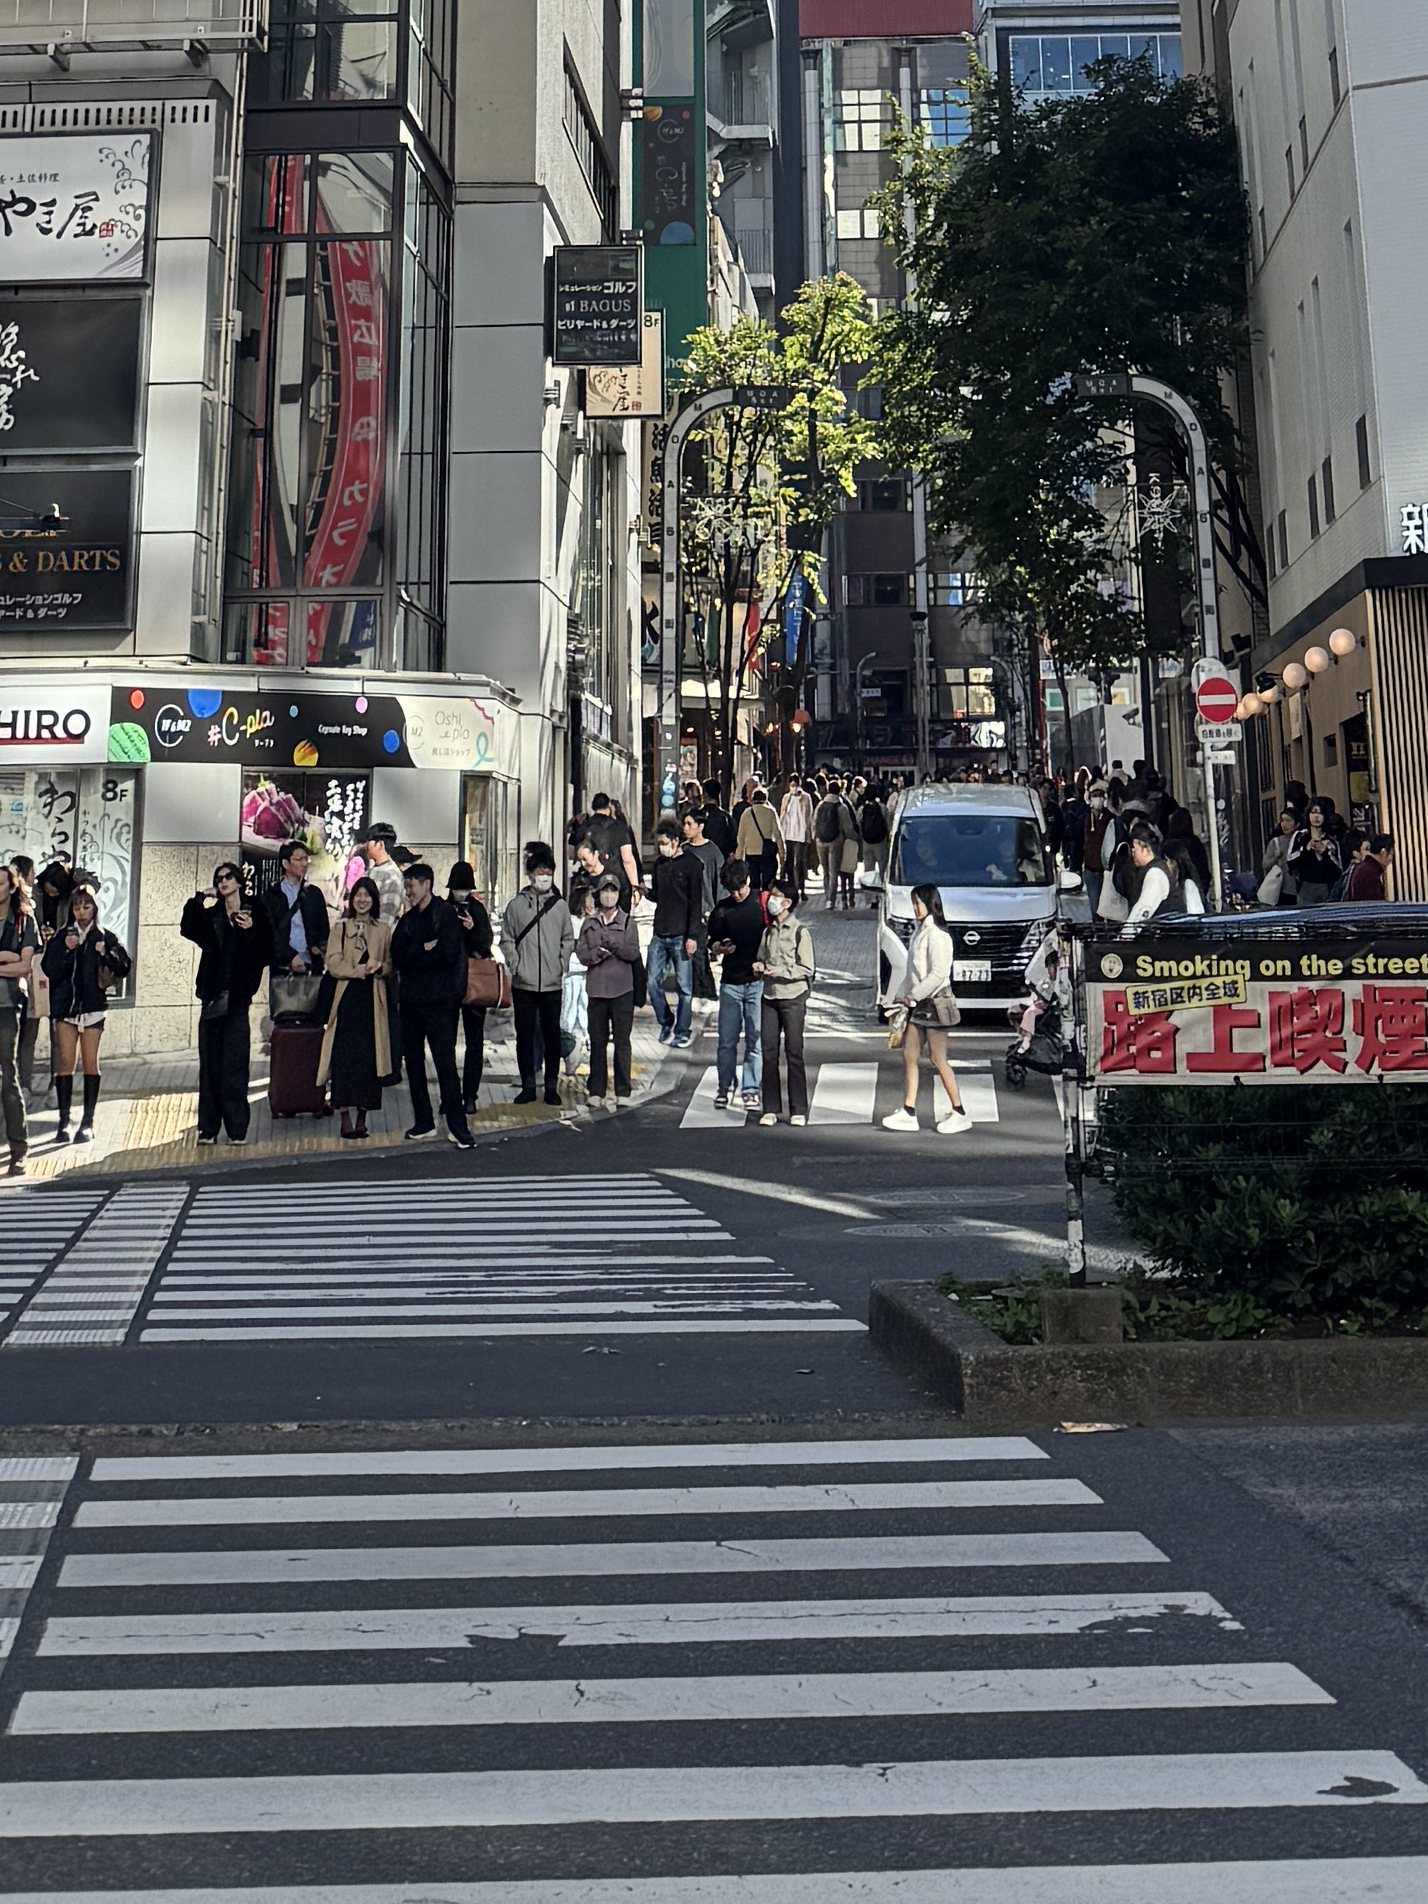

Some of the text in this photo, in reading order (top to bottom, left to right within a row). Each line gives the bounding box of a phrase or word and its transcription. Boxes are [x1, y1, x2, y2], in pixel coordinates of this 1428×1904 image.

[580, 300, 631, 312] BAGUS
[644, 315, 659, 327] 8F
[8, 552, 28, 572] &
[37, 550, 121, 573] DARTS
[101, 779, 129, 802] 8F
[1135, 953, 1250, 979] Smoking
[1260, 958, 1293, 976] on
[1301, 953, 1343, 976] the
[1131, 979, 1242, 1011] 新宿区内全域
